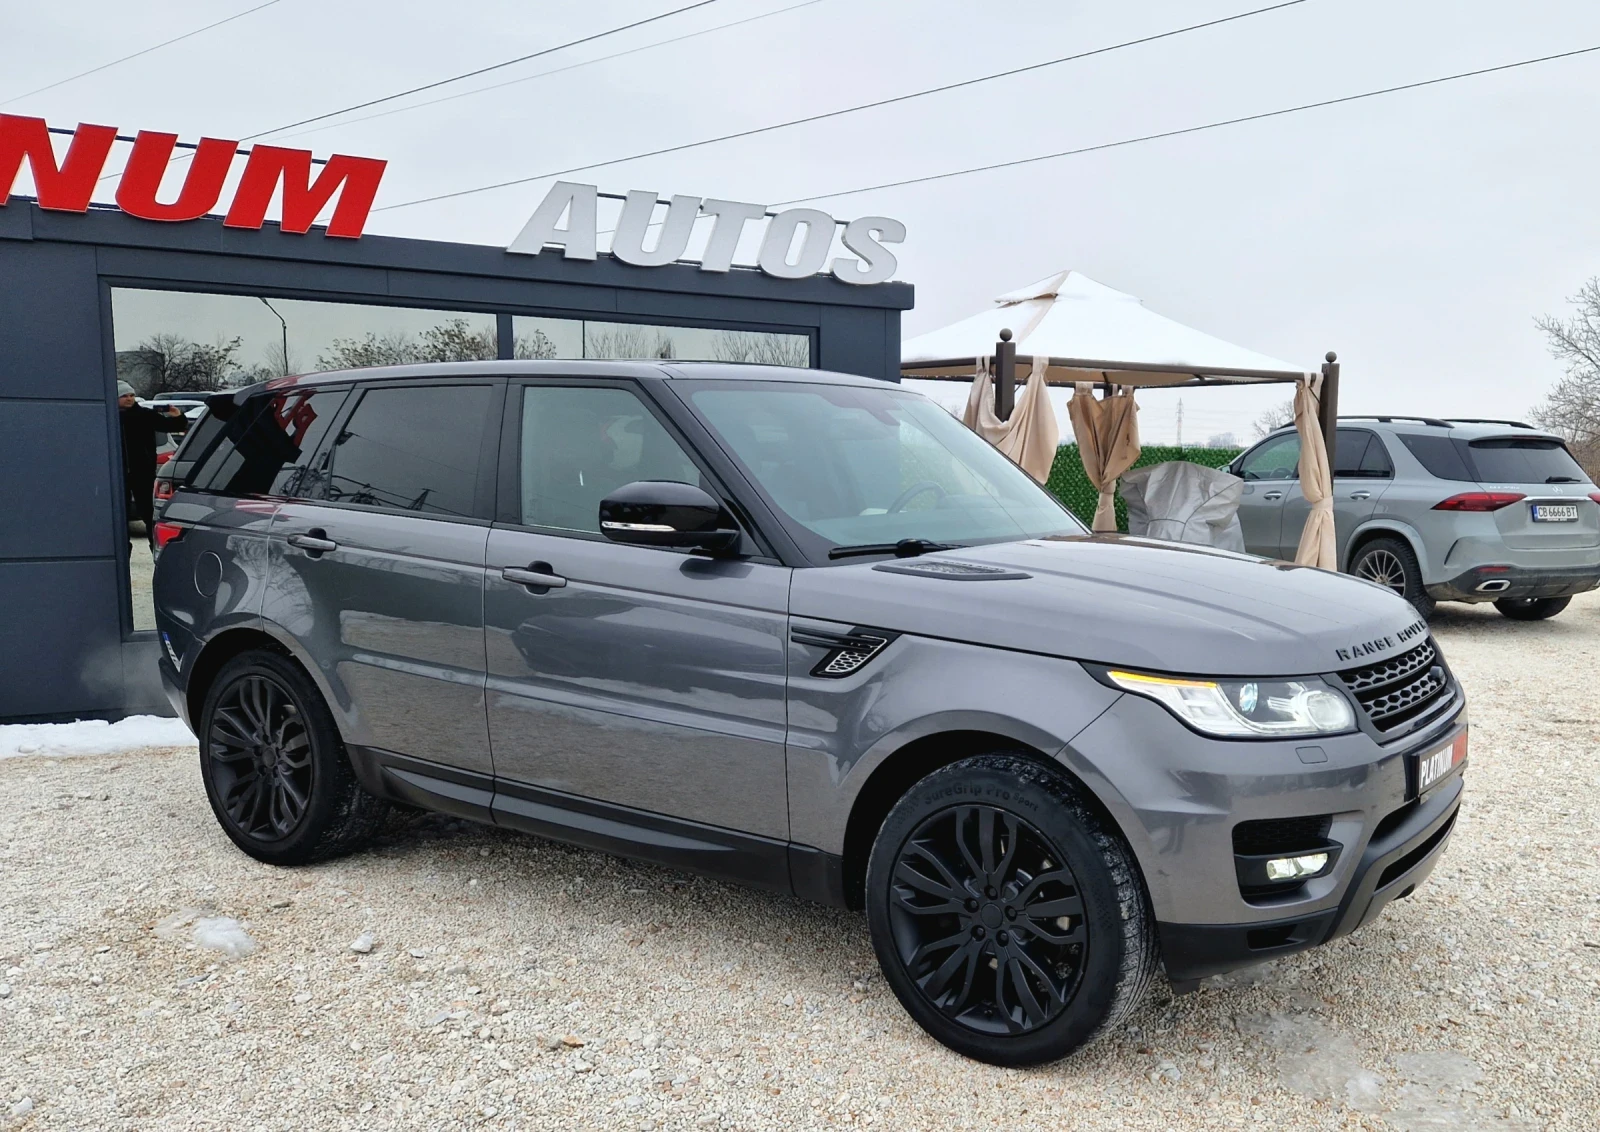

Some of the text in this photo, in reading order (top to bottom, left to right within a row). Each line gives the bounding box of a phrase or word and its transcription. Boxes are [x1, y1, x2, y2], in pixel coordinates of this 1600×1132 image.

[0, 113, 907, 286] NUM AUTOS
[1538, 506, 1576, 517] CB 6666 BT
[1335, 636, 1396, 662] RANGE
[985, 783, 1011, 800] Pro
[1013, 792, 1039, 812] Sport
